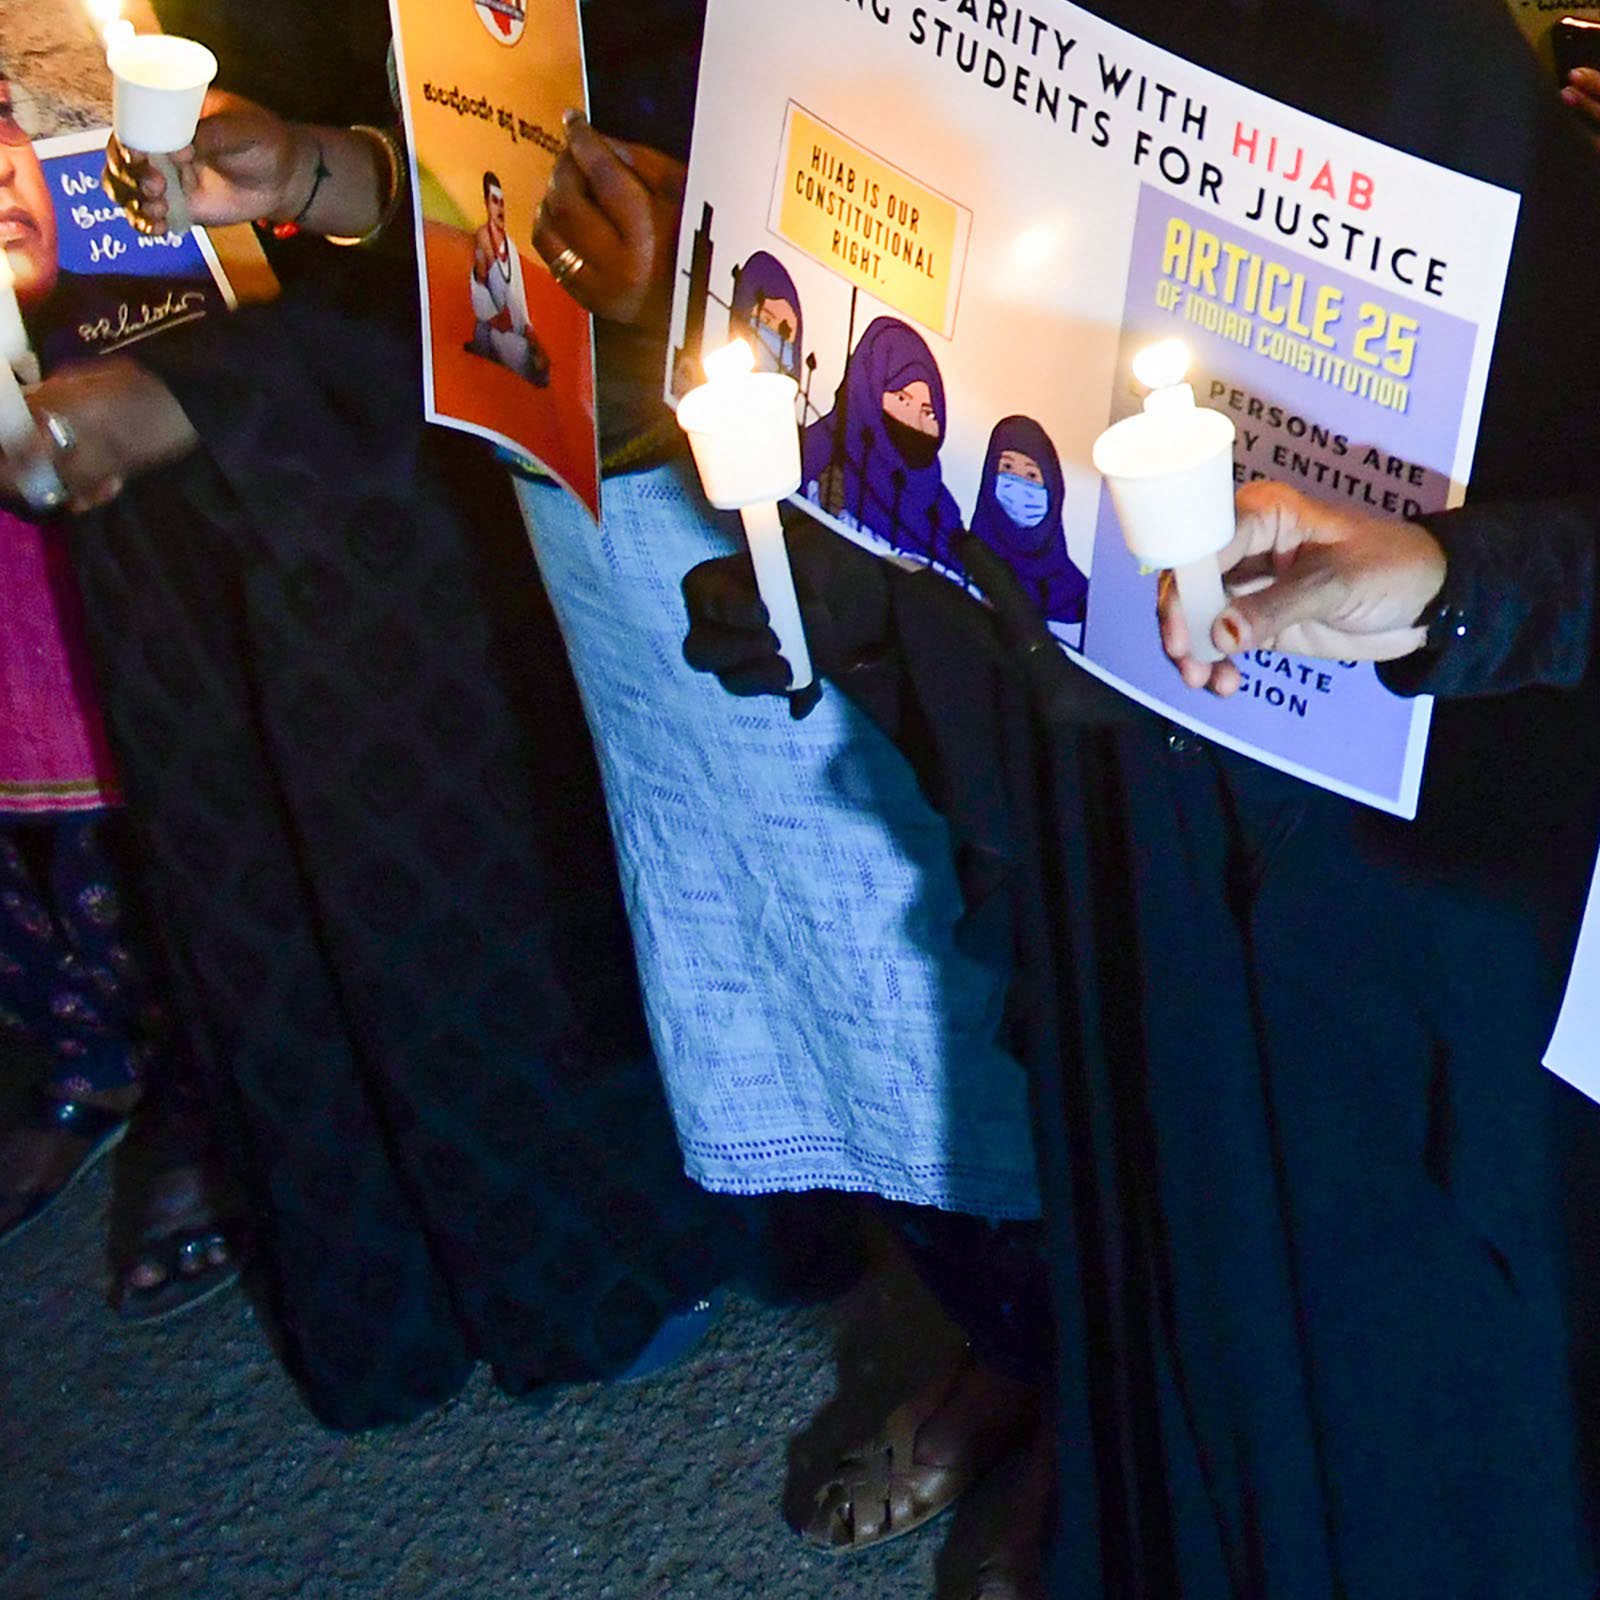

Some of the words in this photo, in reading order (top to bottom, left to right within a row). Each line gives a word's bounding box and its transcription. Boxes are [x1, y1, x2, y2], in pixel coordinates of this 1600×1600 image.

[908, 7, 1113, 150] STUDENTS
[1134, 132, 1226, 205] FOR
[1245, 186, 1450, 299] JUSTICE
[1097, 51, 1210, 140] WITH
[1231, 120, 1377, 212] HIJAB
[794, 169, 937, 281] CONSTITUTIONAL
[809, 143, 858, 196] HIJAB
[861, 174, 883, 210] IS
[886, 192, 921, 236] OUR
[831, 228, 888, 287] RIGHT.
[1163, 215, 1344, 350] ARTICLE
[1357, 302, 1422, 381] 25
[1153, 278, 1181, 312] OF
[1184, 290, 1254, 346] INDIAN
[1254, 323, 1412, 415] CONSTITUTION
[1208, 379, 1349, 457] PERSONS
[1362, 447, 1426, 488] ARE
[1272, 444, 1423, 522] ENTITLED
